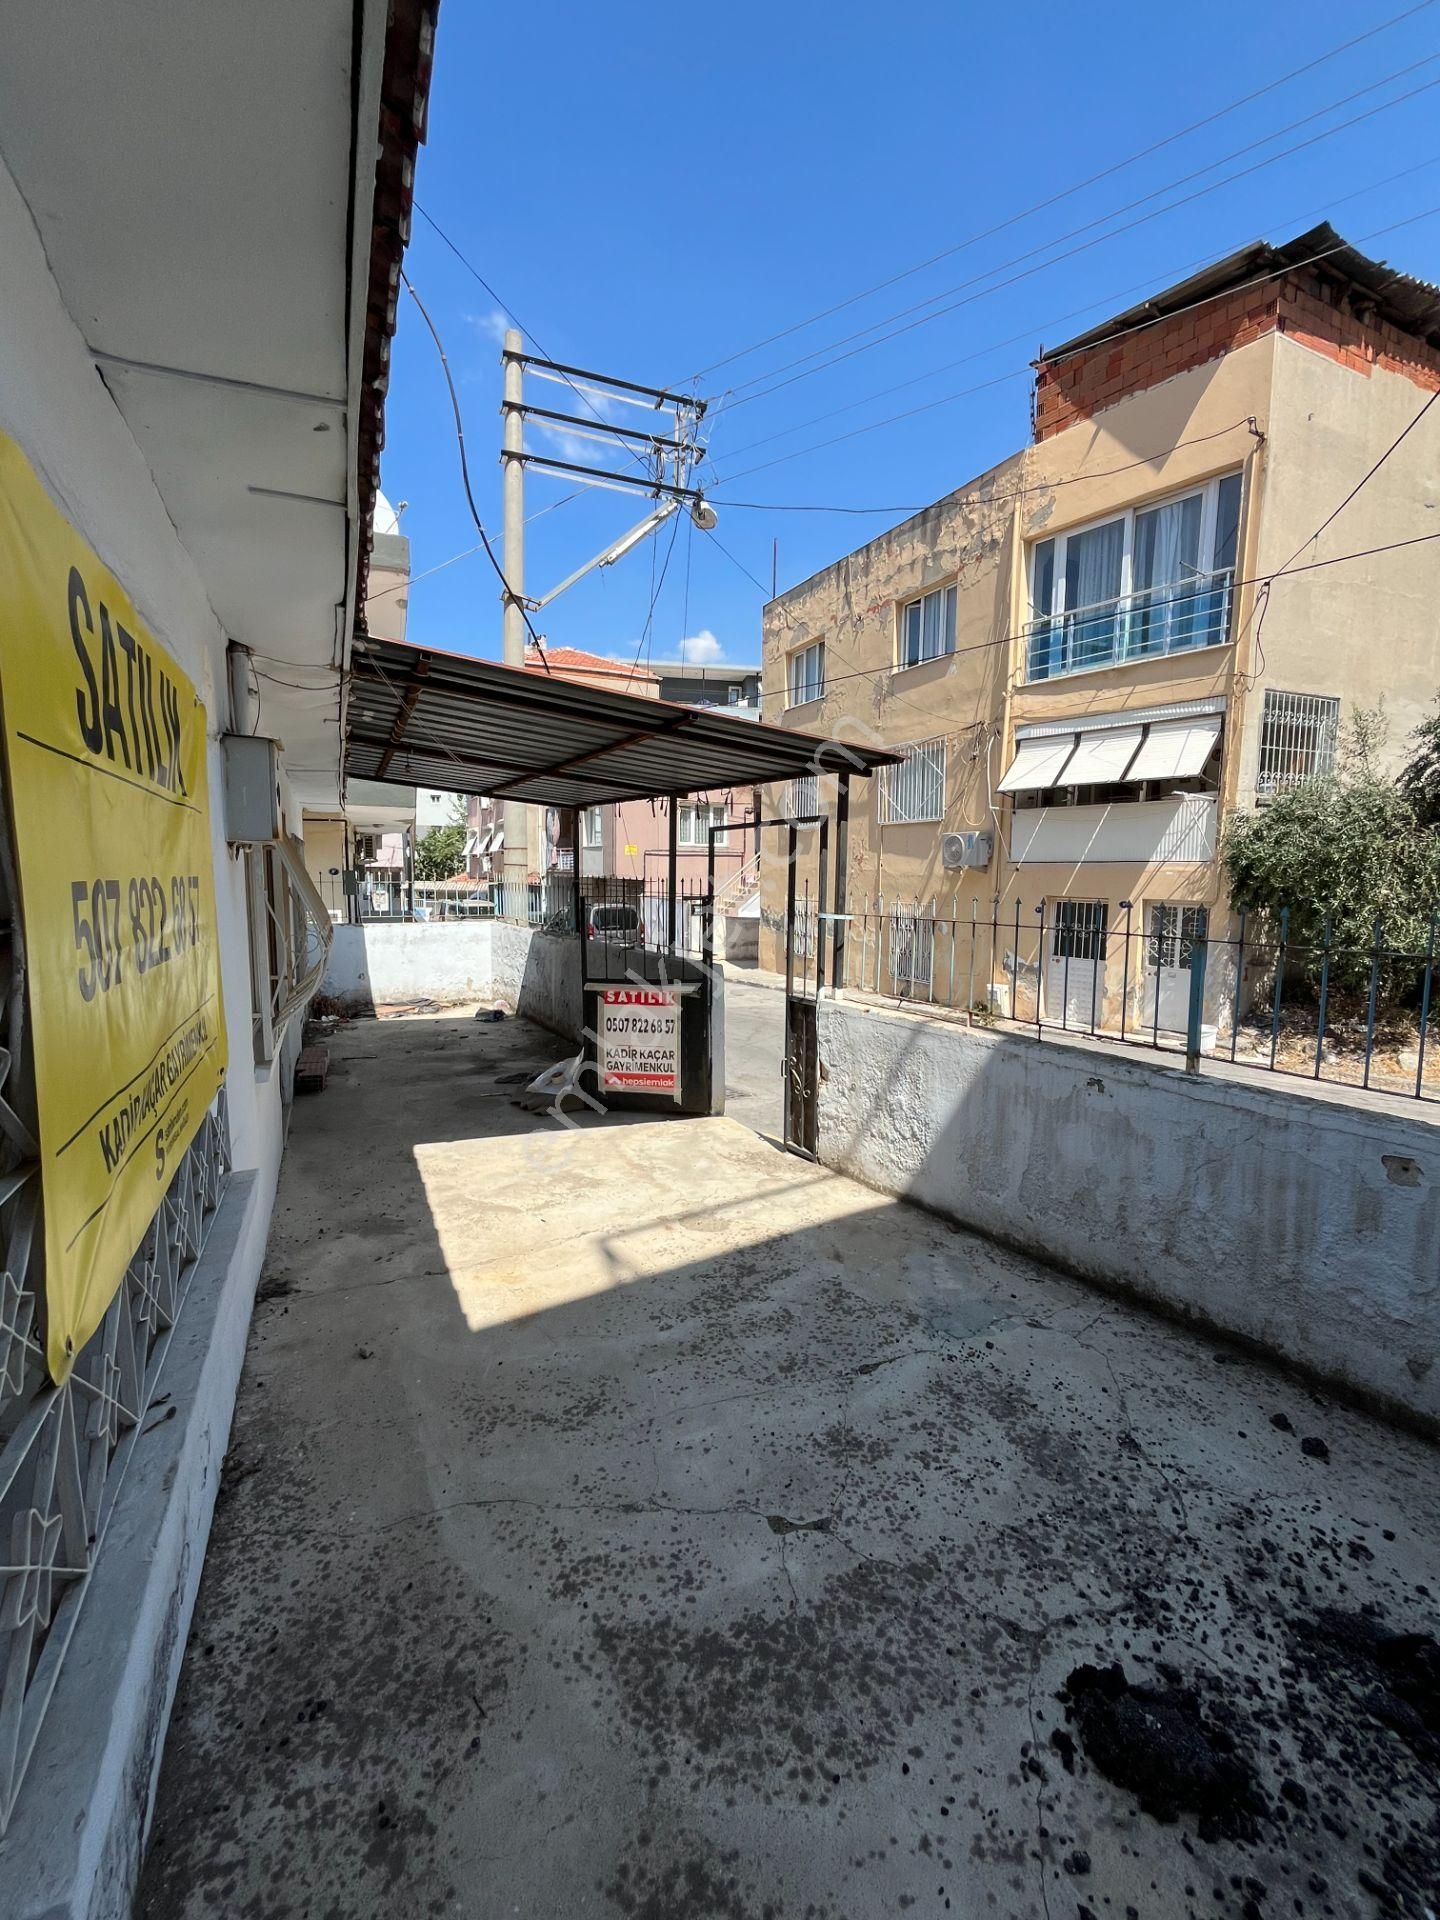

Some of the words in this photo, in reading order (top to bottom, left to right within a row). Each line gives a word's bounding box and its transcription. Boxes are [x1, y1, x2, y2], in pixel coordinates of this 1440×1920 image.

[68, 566, 187, 796] SATILIK
[71, 878, 122, 1003] 507
[128, 876, 171, 974] 822
[171, 875, 186, 956] 68
[606, 991, 675, 1004] SATILIK
[606, 1017, 630, 1033] 0507
[631, 1018, 649, 1034] 822
[650, 1019, 663, 1034] 68
[664, 1019, 675, 1034] 57
[606, 1046, 638, 1061] KADİR
[639, 1049, 675, 1063] KAÇAR
[622, 1077, 675, 1088] hepsiemlak
